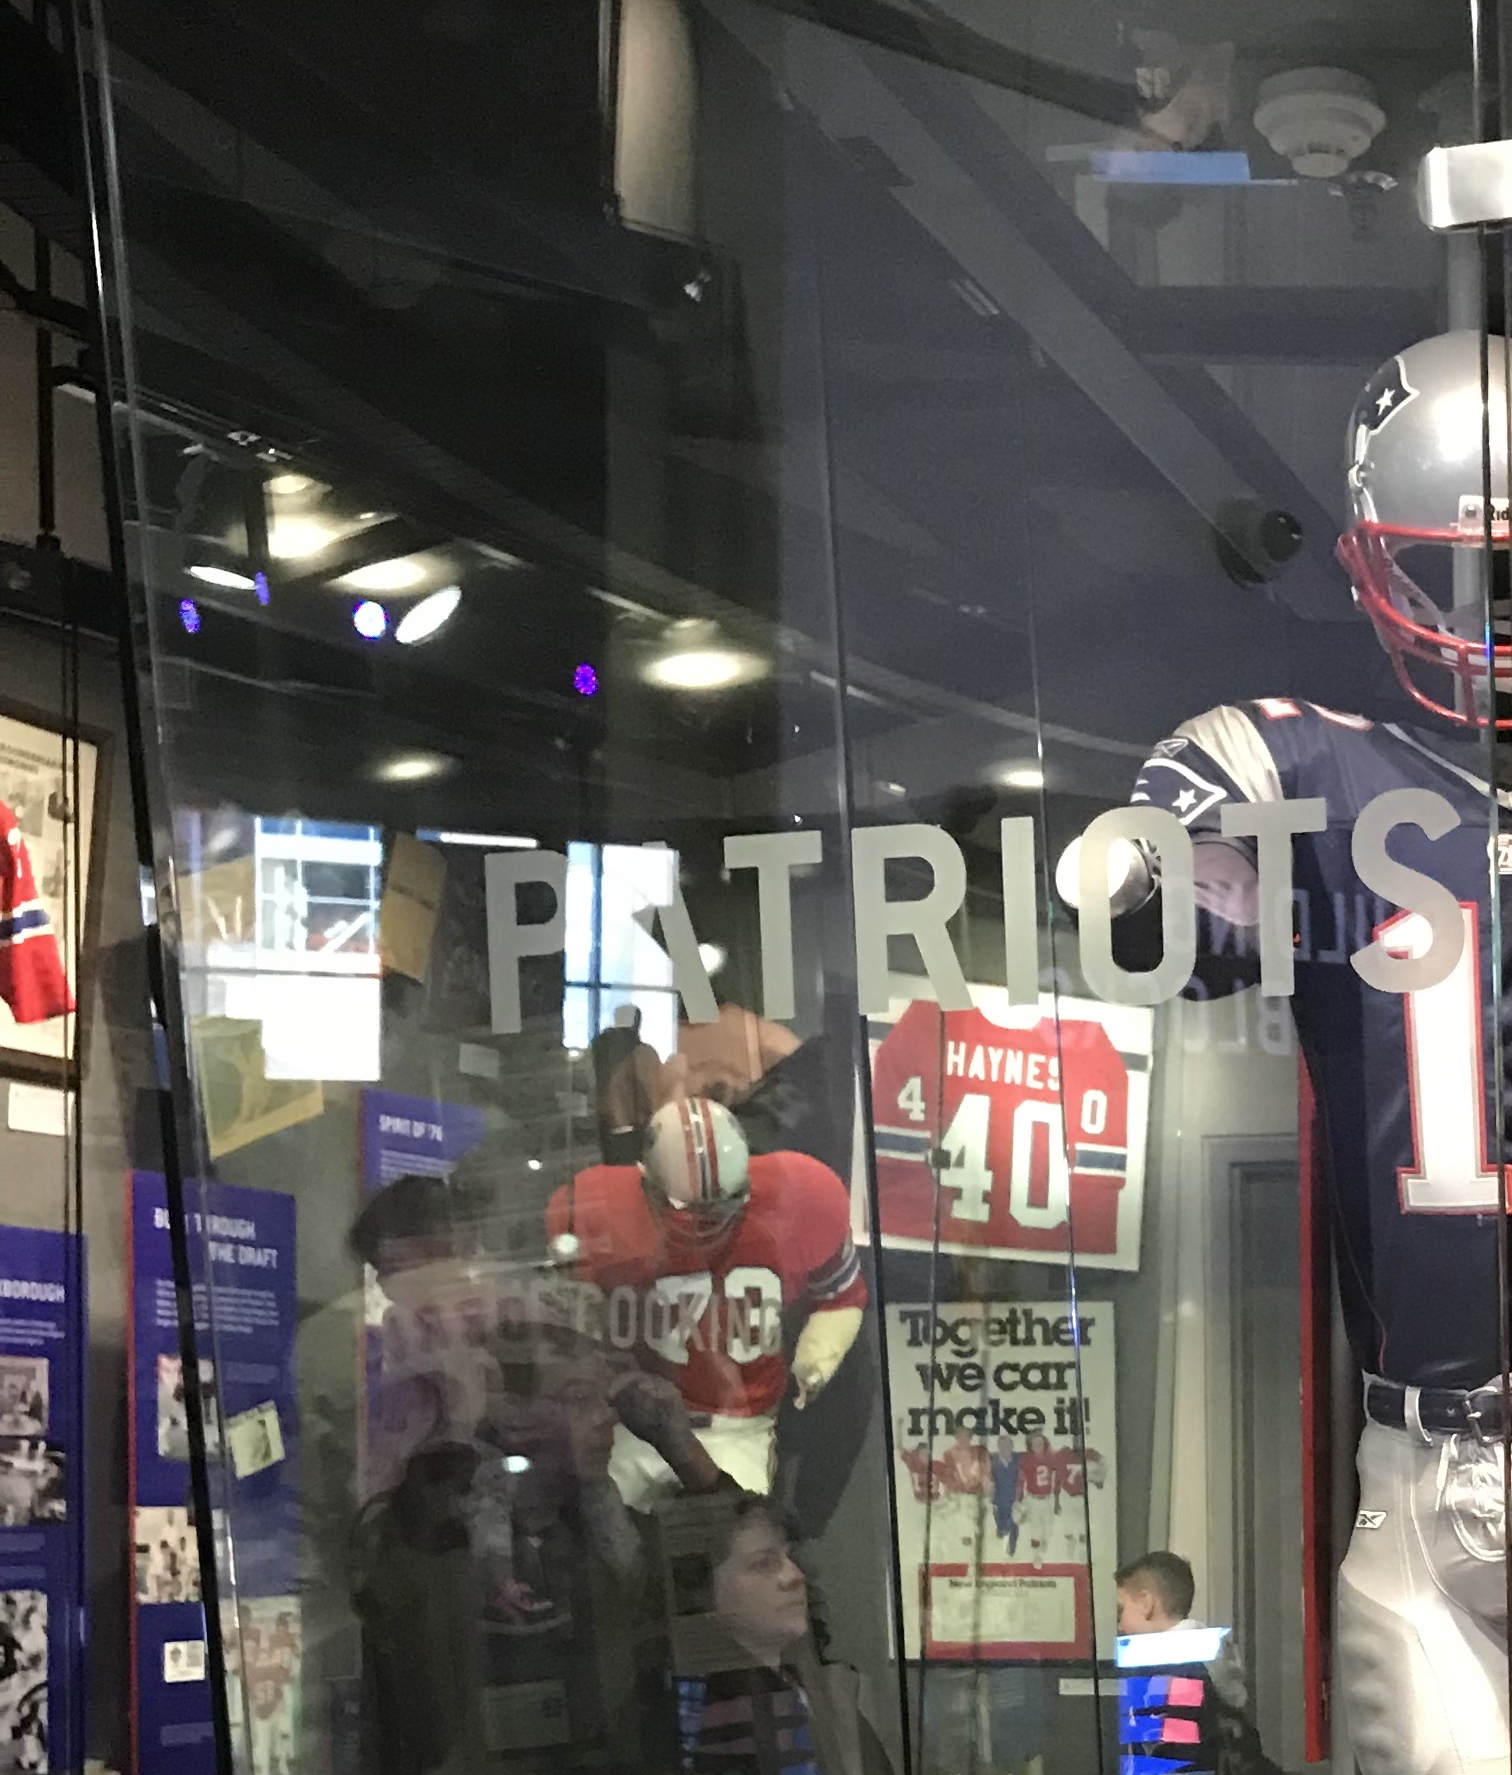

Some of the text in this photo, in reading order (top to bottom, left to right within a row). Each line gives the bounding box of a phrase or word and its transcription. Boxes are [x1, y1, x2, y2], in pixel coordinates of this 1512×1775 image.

[485, 788, 1465, 1034] PATRIOTS
[947, 1040, 1060, 1091] HAYNES
[897, 1075, 926, 1122] 4
[379, 1114, 411, 1137] SPIRIT
[939, 1093, 1070, 1230] 40
[237, 1246, 279, 1269] DRAFT
[899, 1307, 1096, 1359] Together
[916, 1361, 986, 1392] we
[908, 1398, 1046, 1436] make
